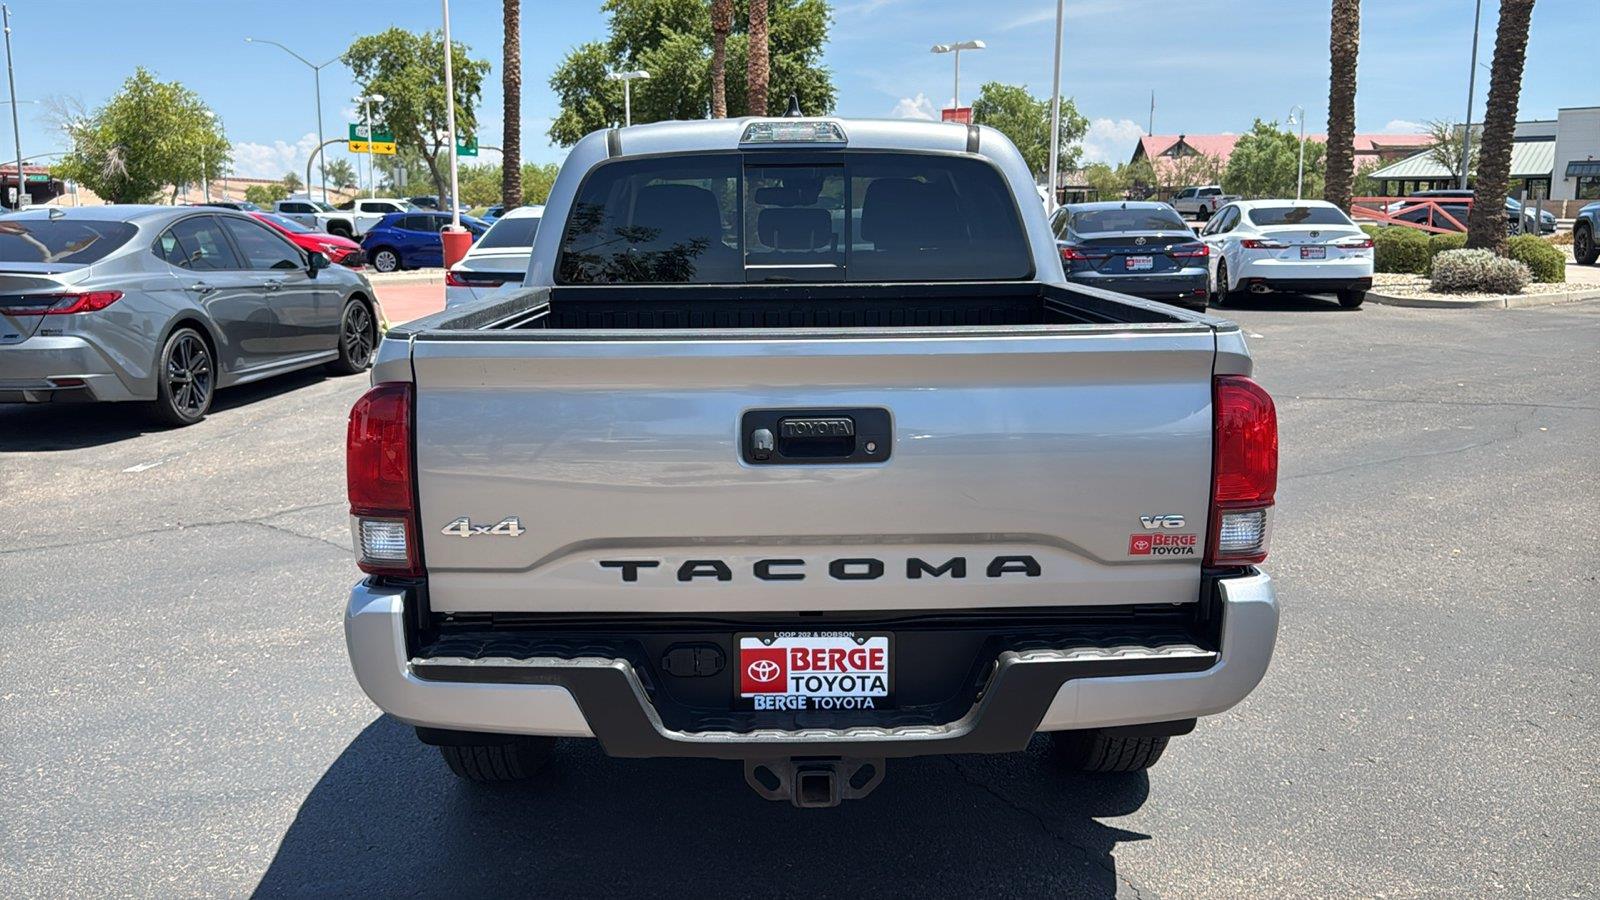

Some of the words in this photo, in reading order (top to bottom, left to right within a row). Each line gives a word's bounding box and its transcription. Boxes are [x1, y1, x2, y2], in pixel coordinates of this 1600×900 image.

[785, 421, 851, 434] TOYOTA
[440, 516, 526, 538] 4x4
[1140, 515, 1186, 529] V6
[1153, 533, 1197, 546] BERGE
[1152, 547, 1194, 555] TOYOTA
[600, 556, 1042, 582] TACOMA
[790, 648, 885, 673] BERGE
[791, 676, 887, 693] TOYOTA
[753, 695, 807, 711] BERGE
[812, 697, 875, 710] TOYOTA
